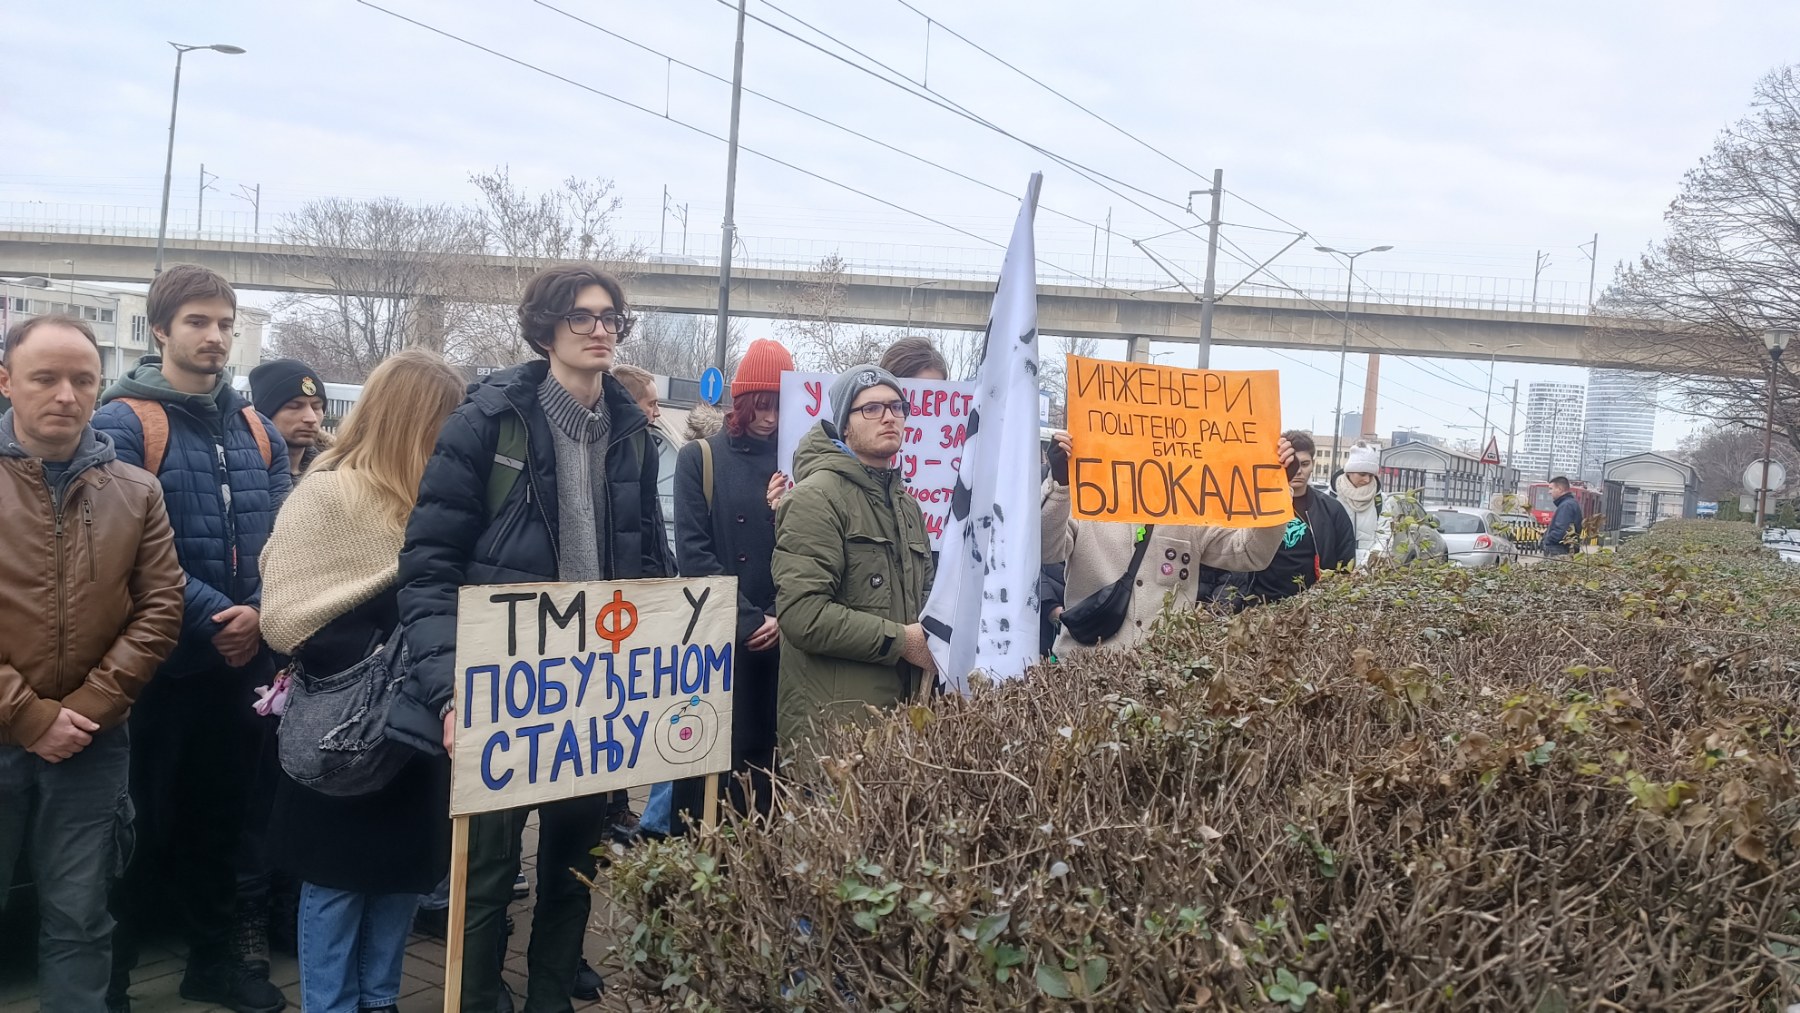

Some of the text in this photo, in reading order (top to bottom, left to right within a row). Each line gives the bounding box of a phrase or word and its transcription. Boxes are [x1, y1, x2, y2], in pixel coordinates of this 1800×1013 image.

[804, 381, 822, 417] У
[1075, 359, 1253, 415] ИНЖЕЊЕРИ
[903, 426, 923, 444] ТА
[1088, 409, 1258, 444] ПОШТЕНО РАДЕ
[1152, 441, 1204, 459] БИЋЕ
[1075, 457, 1286, 522] БЛОКАДЕ
[489, 586, 711, 656] ТМФ У
[464, 642, 732, 728] ПОБУЂЕНОМ
[480, 711, 650, 791] СТАЊУ
